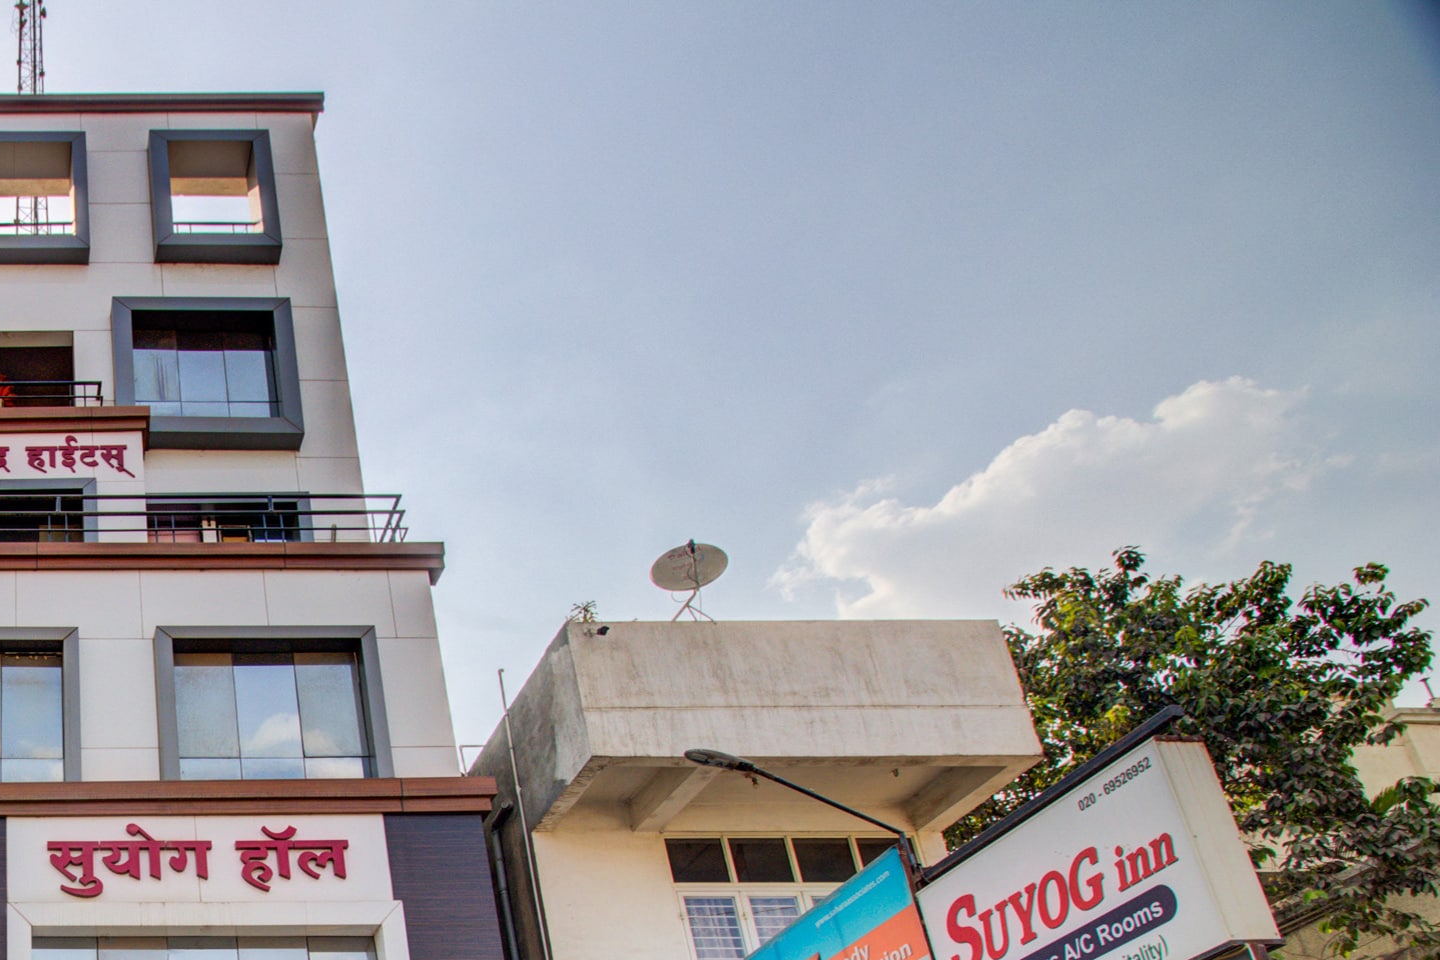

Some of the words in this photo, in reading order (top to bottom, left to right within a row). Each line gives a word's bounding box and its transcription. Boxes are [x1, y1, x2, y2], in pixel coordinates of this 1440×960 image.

[1077, 792, 1096, 812] 020
[1103, 756, 1152, 796] 69526952
[47, 823, 212, 898] सुयोग
[235, 825, 349, 892] हॉल
[1114, 832, 1179, 892] inn
[1096, 900, 1164, 947] Rooms
